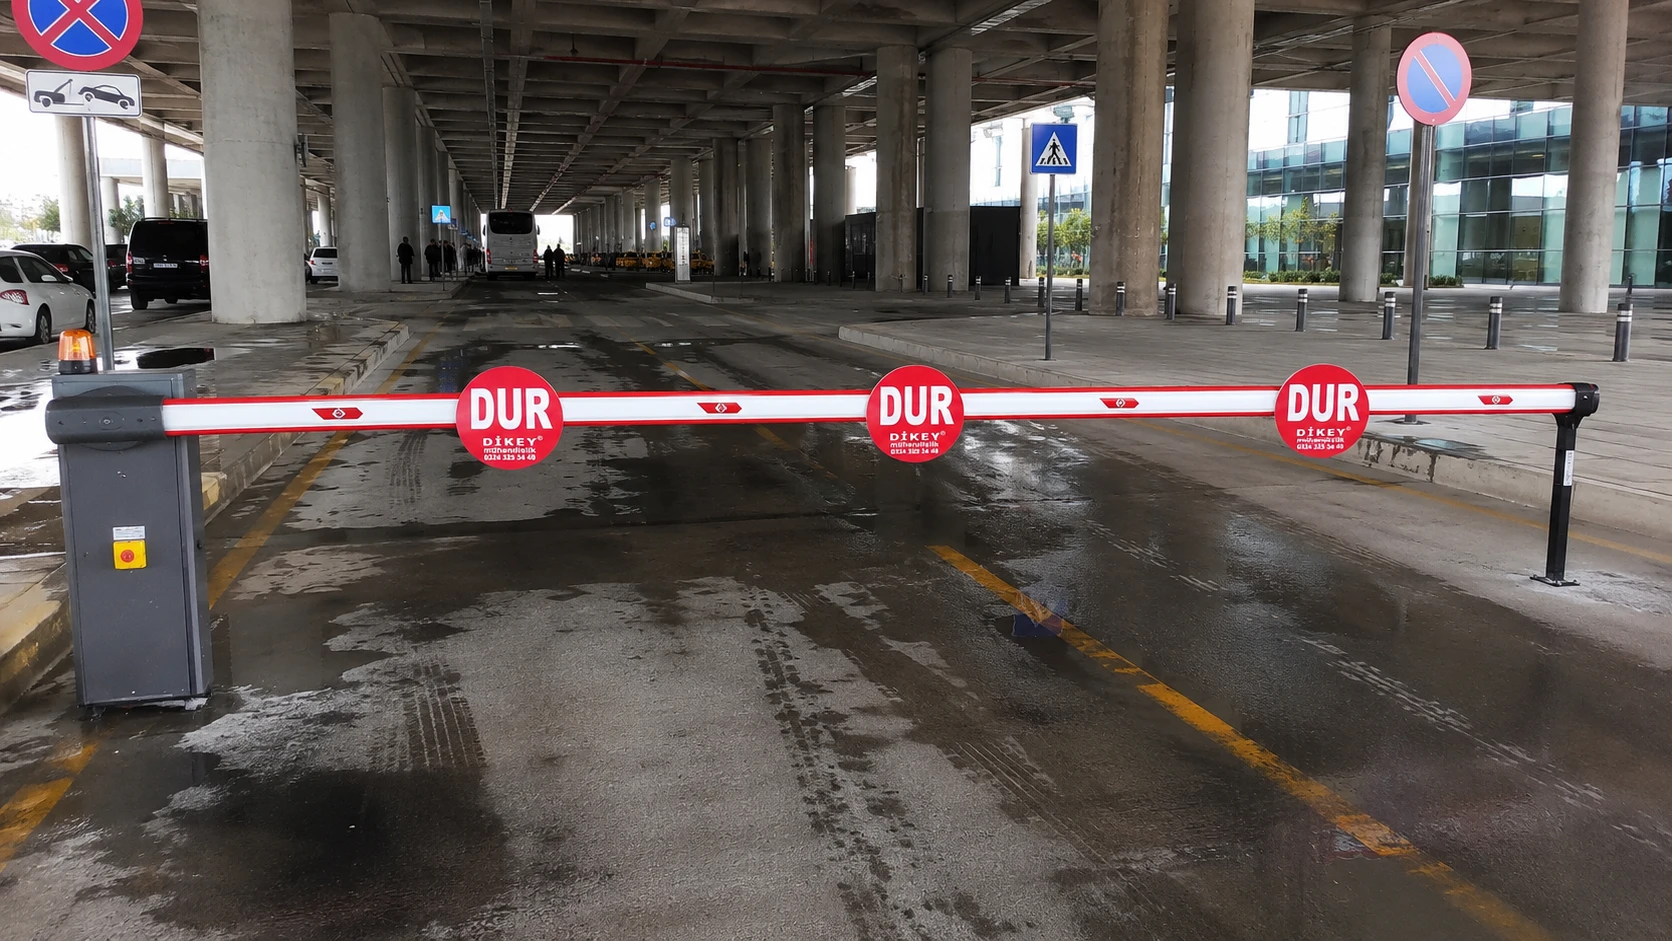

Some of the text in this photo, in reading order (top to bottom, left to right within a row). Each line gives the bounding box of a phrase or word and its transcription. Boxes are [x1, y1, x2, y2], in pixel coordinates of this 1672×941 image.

[470, 387, 553, 430] DUR
[879, 385, 955, 426] DUR
[1287, 383, 1360, 423] DUR
[482, 435, 537, 446] DİKEY
[889, 430, 940, 441] DİKEY
[1296, 426, 1346, 437] DİKEY
